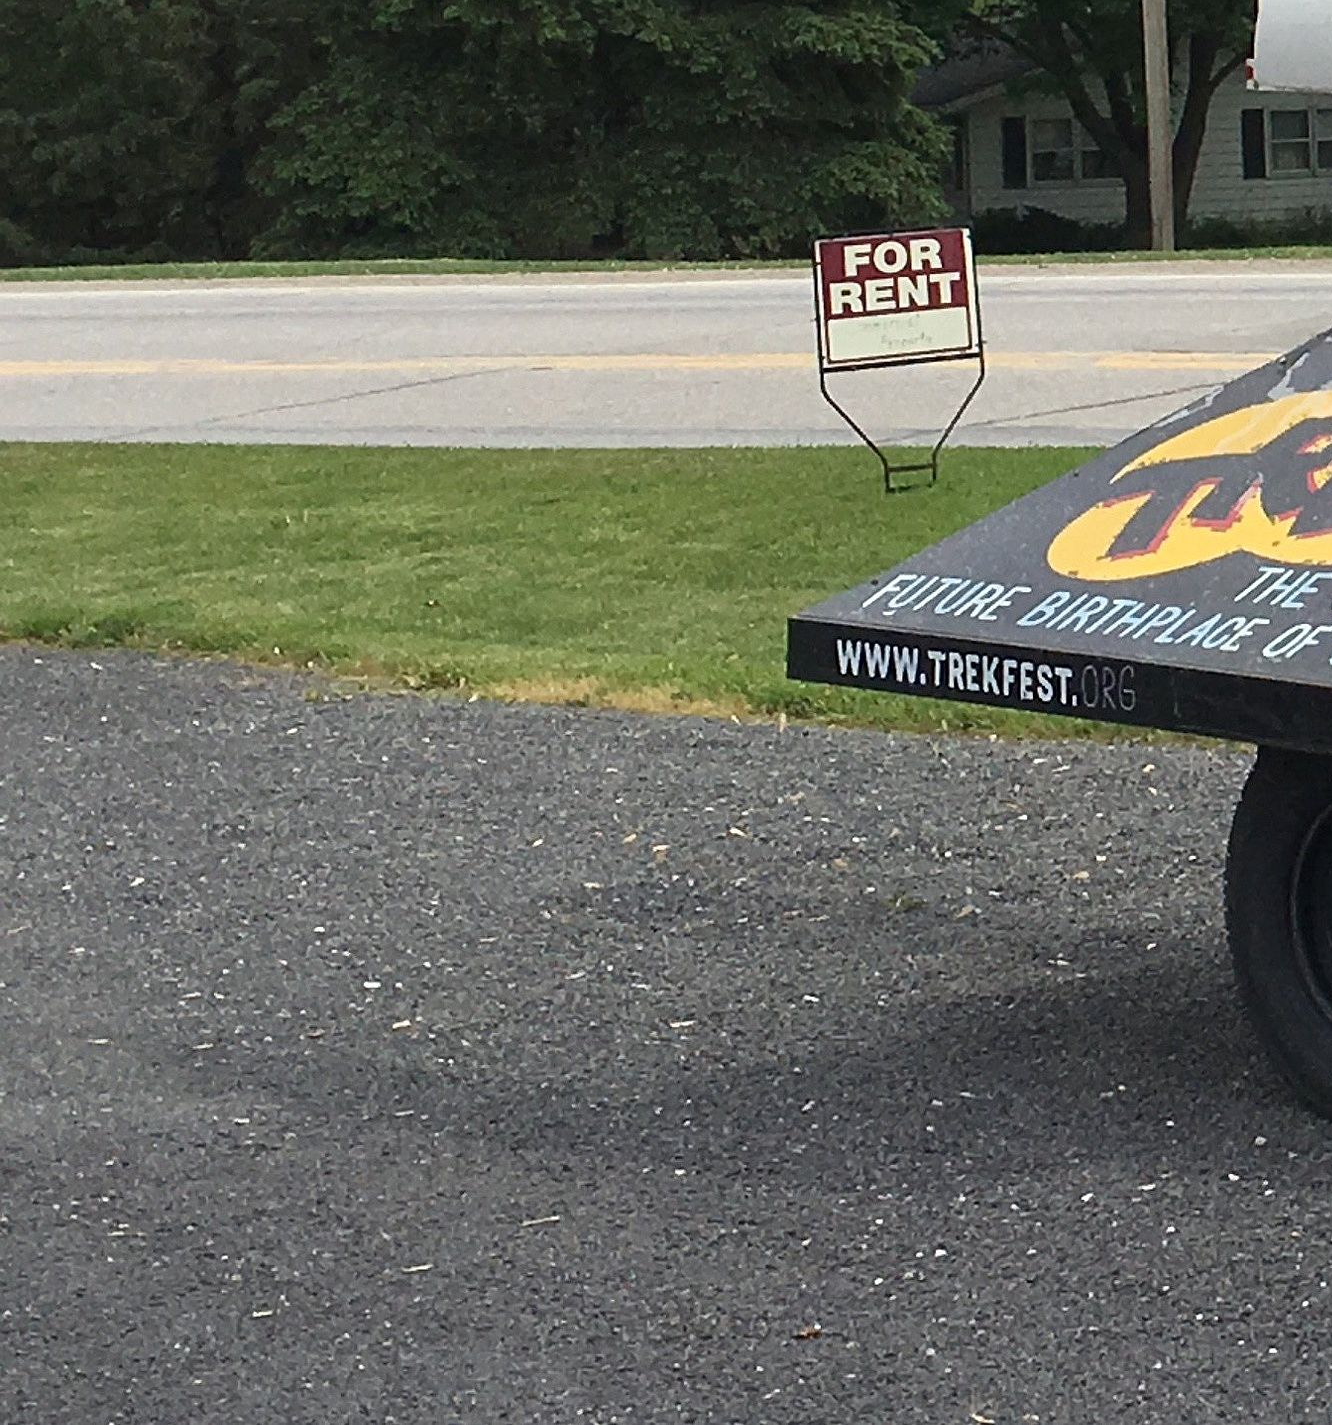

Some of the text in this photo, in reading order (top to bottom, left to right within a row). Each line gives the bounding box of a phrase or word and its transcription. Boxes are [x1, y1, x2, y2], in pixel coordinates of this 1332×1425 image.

[844, 238, 943, 277] FOR
[829, 272, 960, 315] RENT
[1234, 566, 1324, 610] THE
[861, 571, 1032, 625] FUTURE
[1016, 589, 1272, 653] BIRTHPLACE
[835, 638, 1138, 712] WWW.TREKFEST.ORG
